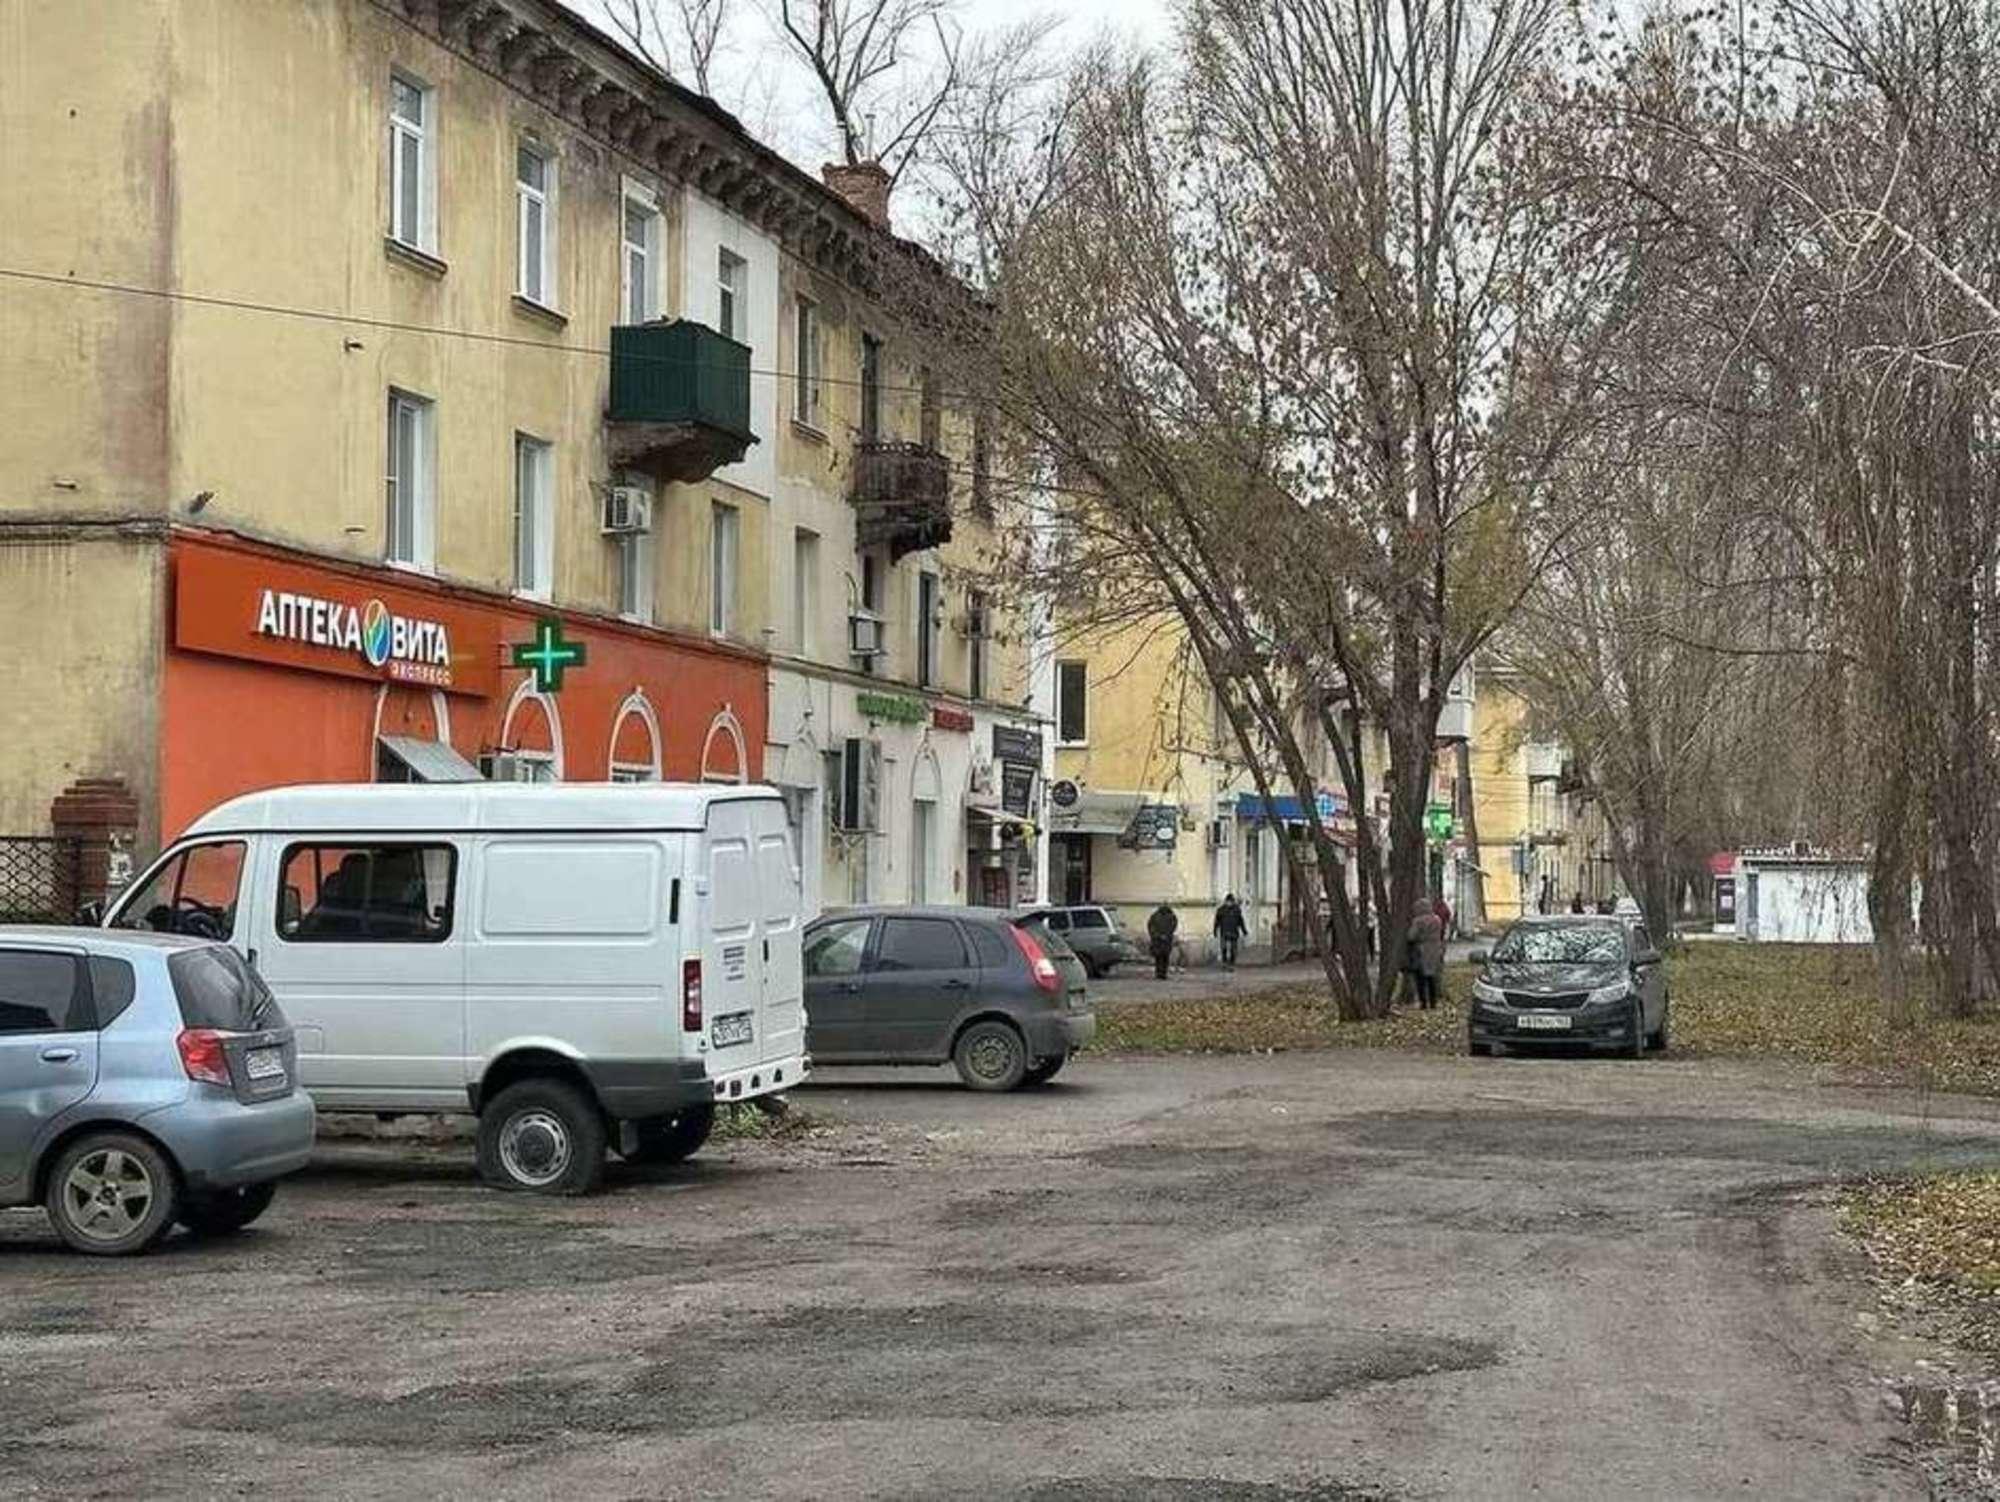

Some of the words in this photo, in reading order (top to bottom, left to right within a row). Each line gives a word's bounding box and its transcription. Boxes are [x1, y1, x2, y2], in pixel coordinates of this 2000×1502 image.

[258, 589, 362, 651] АПТЕКА
[392, 615, 450, 666] ВИТА
[389, 661, 452, 685] ЭКСПРЕСС
